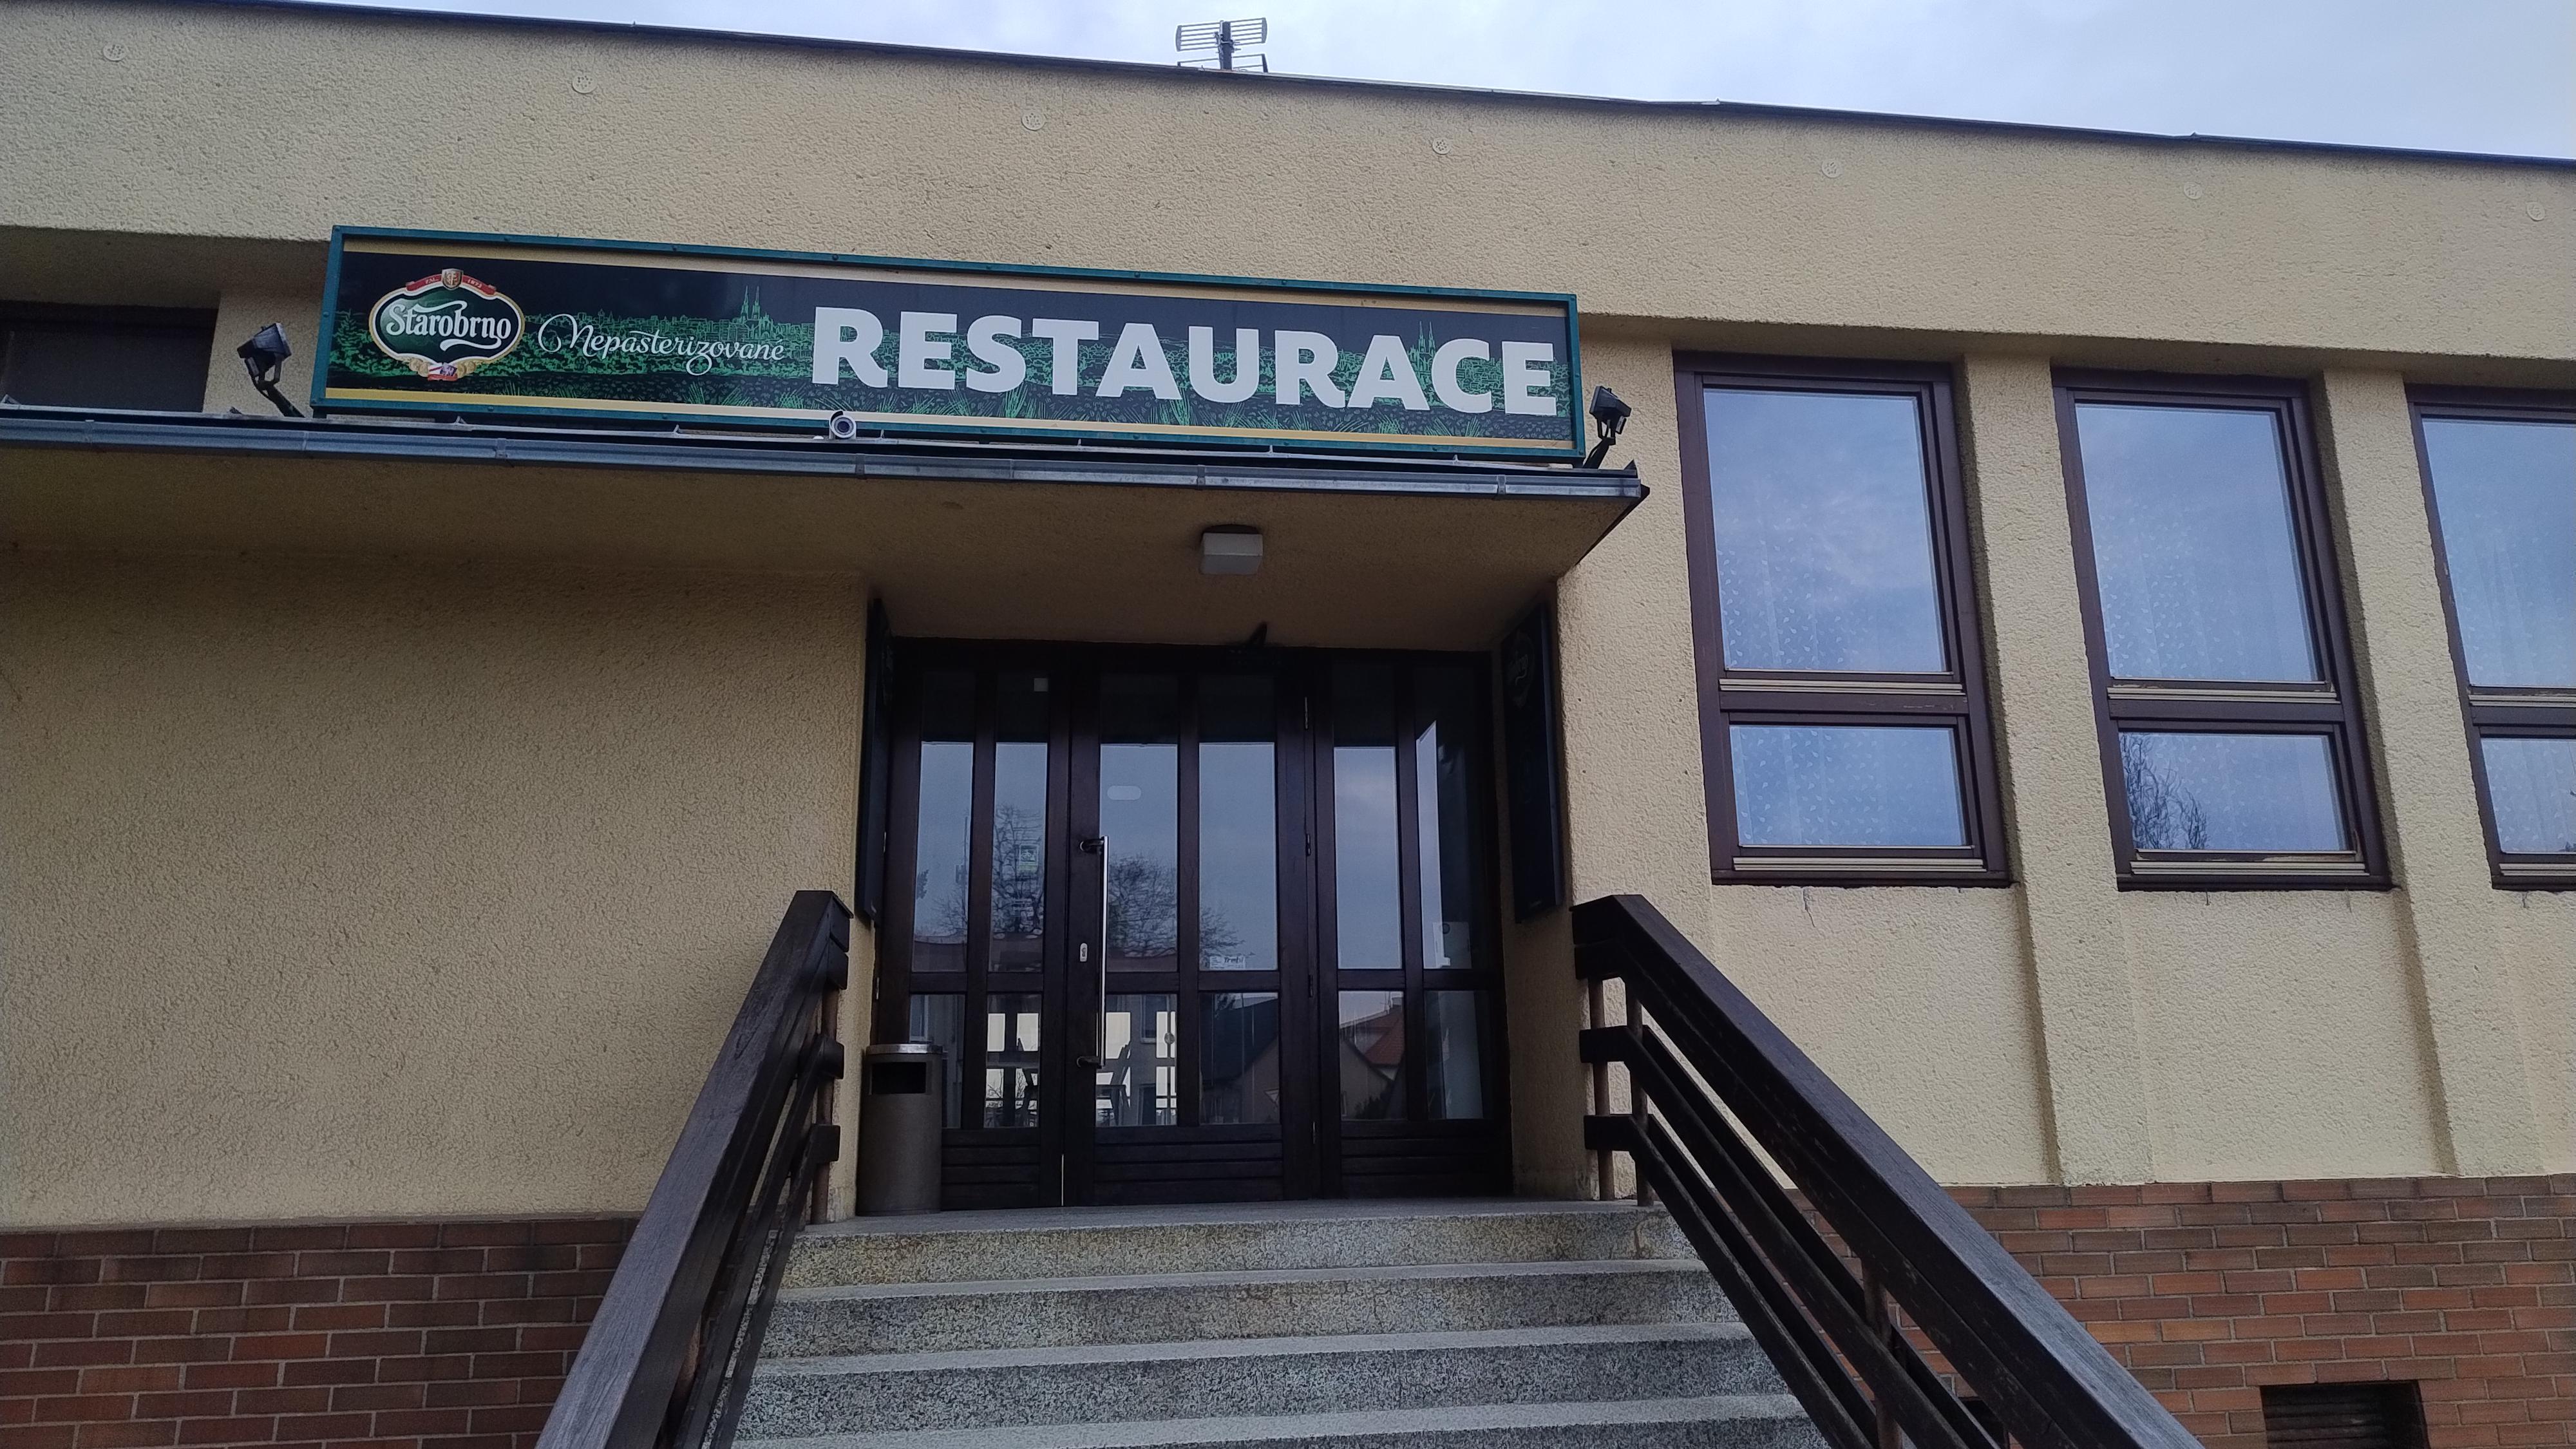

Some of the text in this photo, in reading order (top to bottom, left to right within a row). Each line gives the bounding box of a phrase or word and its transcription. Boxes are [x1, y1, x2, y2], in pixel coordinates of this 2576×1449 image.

[386, 300, 512, 352] Starobrno
[538, 314, 784, 376] Nepasterizované
[811, 306, 1558, 416] RESTAURACE
